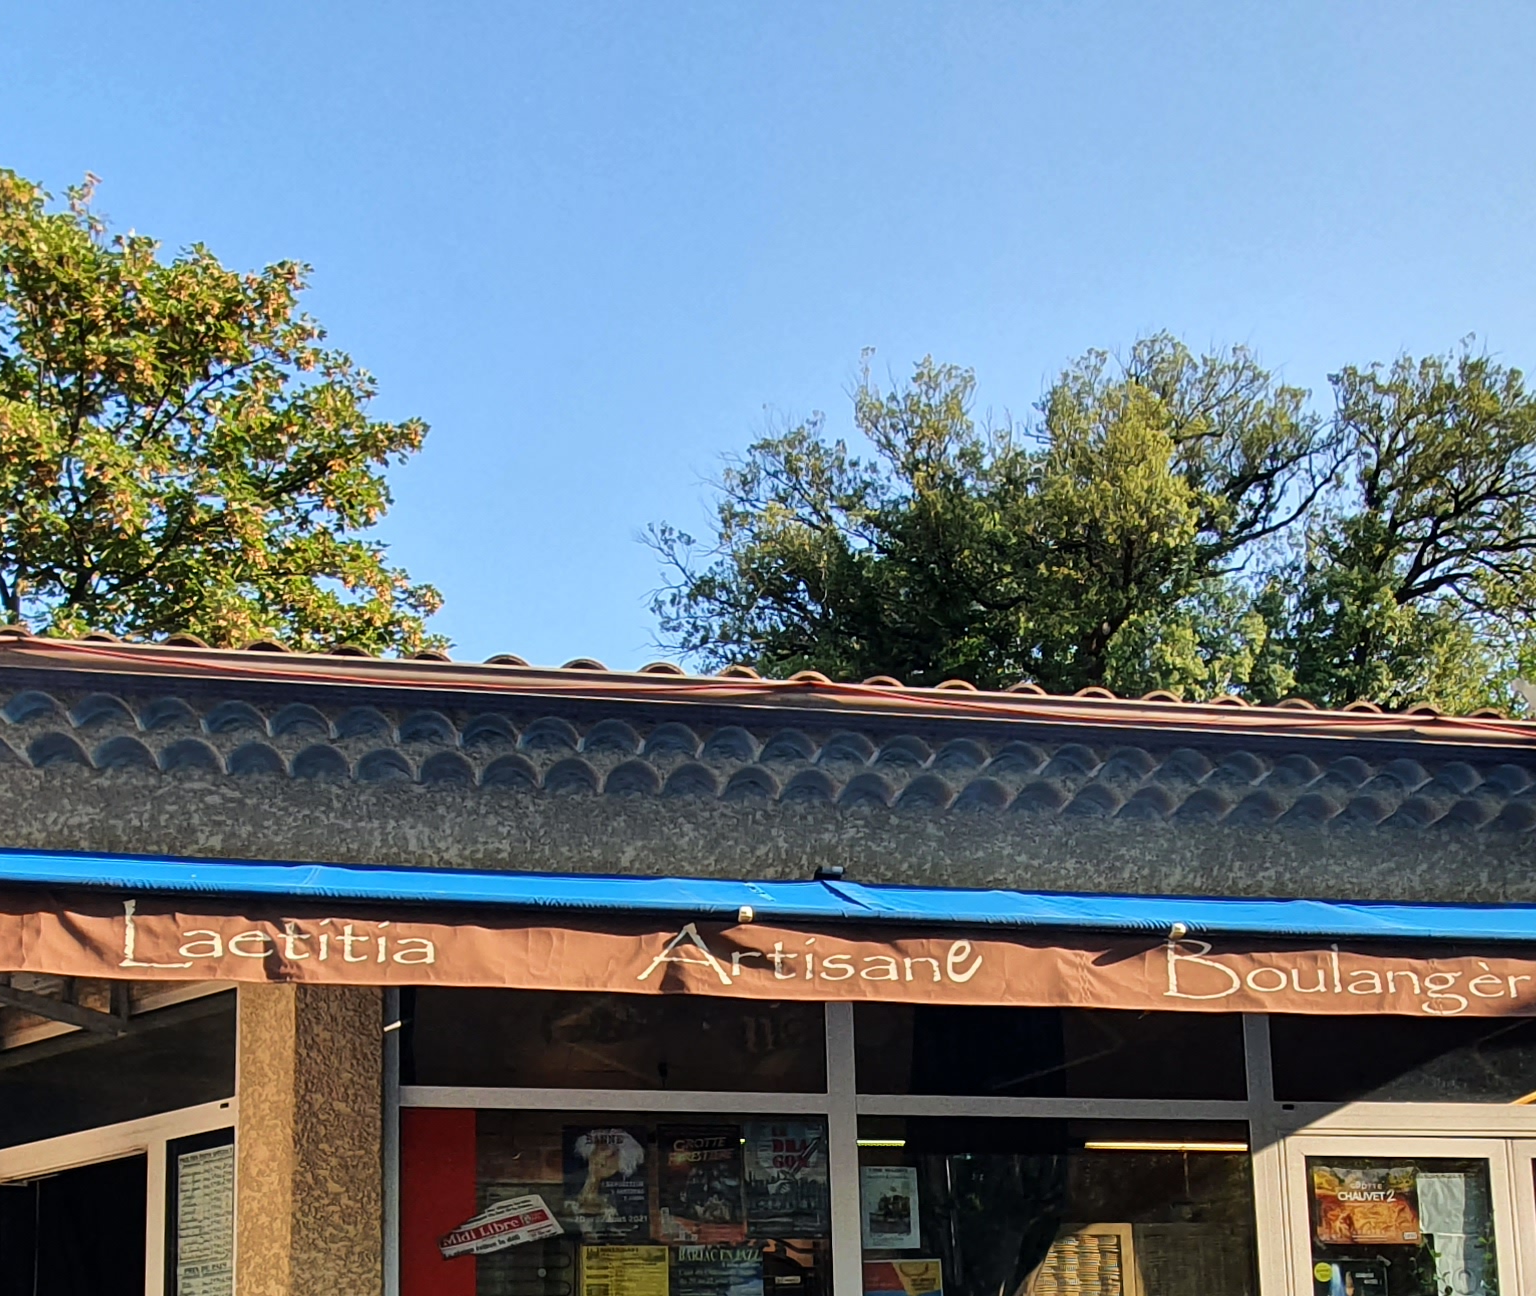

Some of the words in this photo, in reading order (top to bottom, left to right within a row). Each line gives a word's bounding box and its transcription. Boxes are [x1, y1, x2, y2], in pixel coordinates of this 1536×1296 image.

[123, 900, 436, 970] Laetitia
[637, 922, 983, 985] Artisane
[1337, 1191, 1386, 1202] CHAUVET
[1386, 1188, 1397, 1203] 2
[443, 1230, 477, 1247] Midi
[478, 1217, 521, 1238] Libre
[733, 1248, 763, 1263] JAZZ
